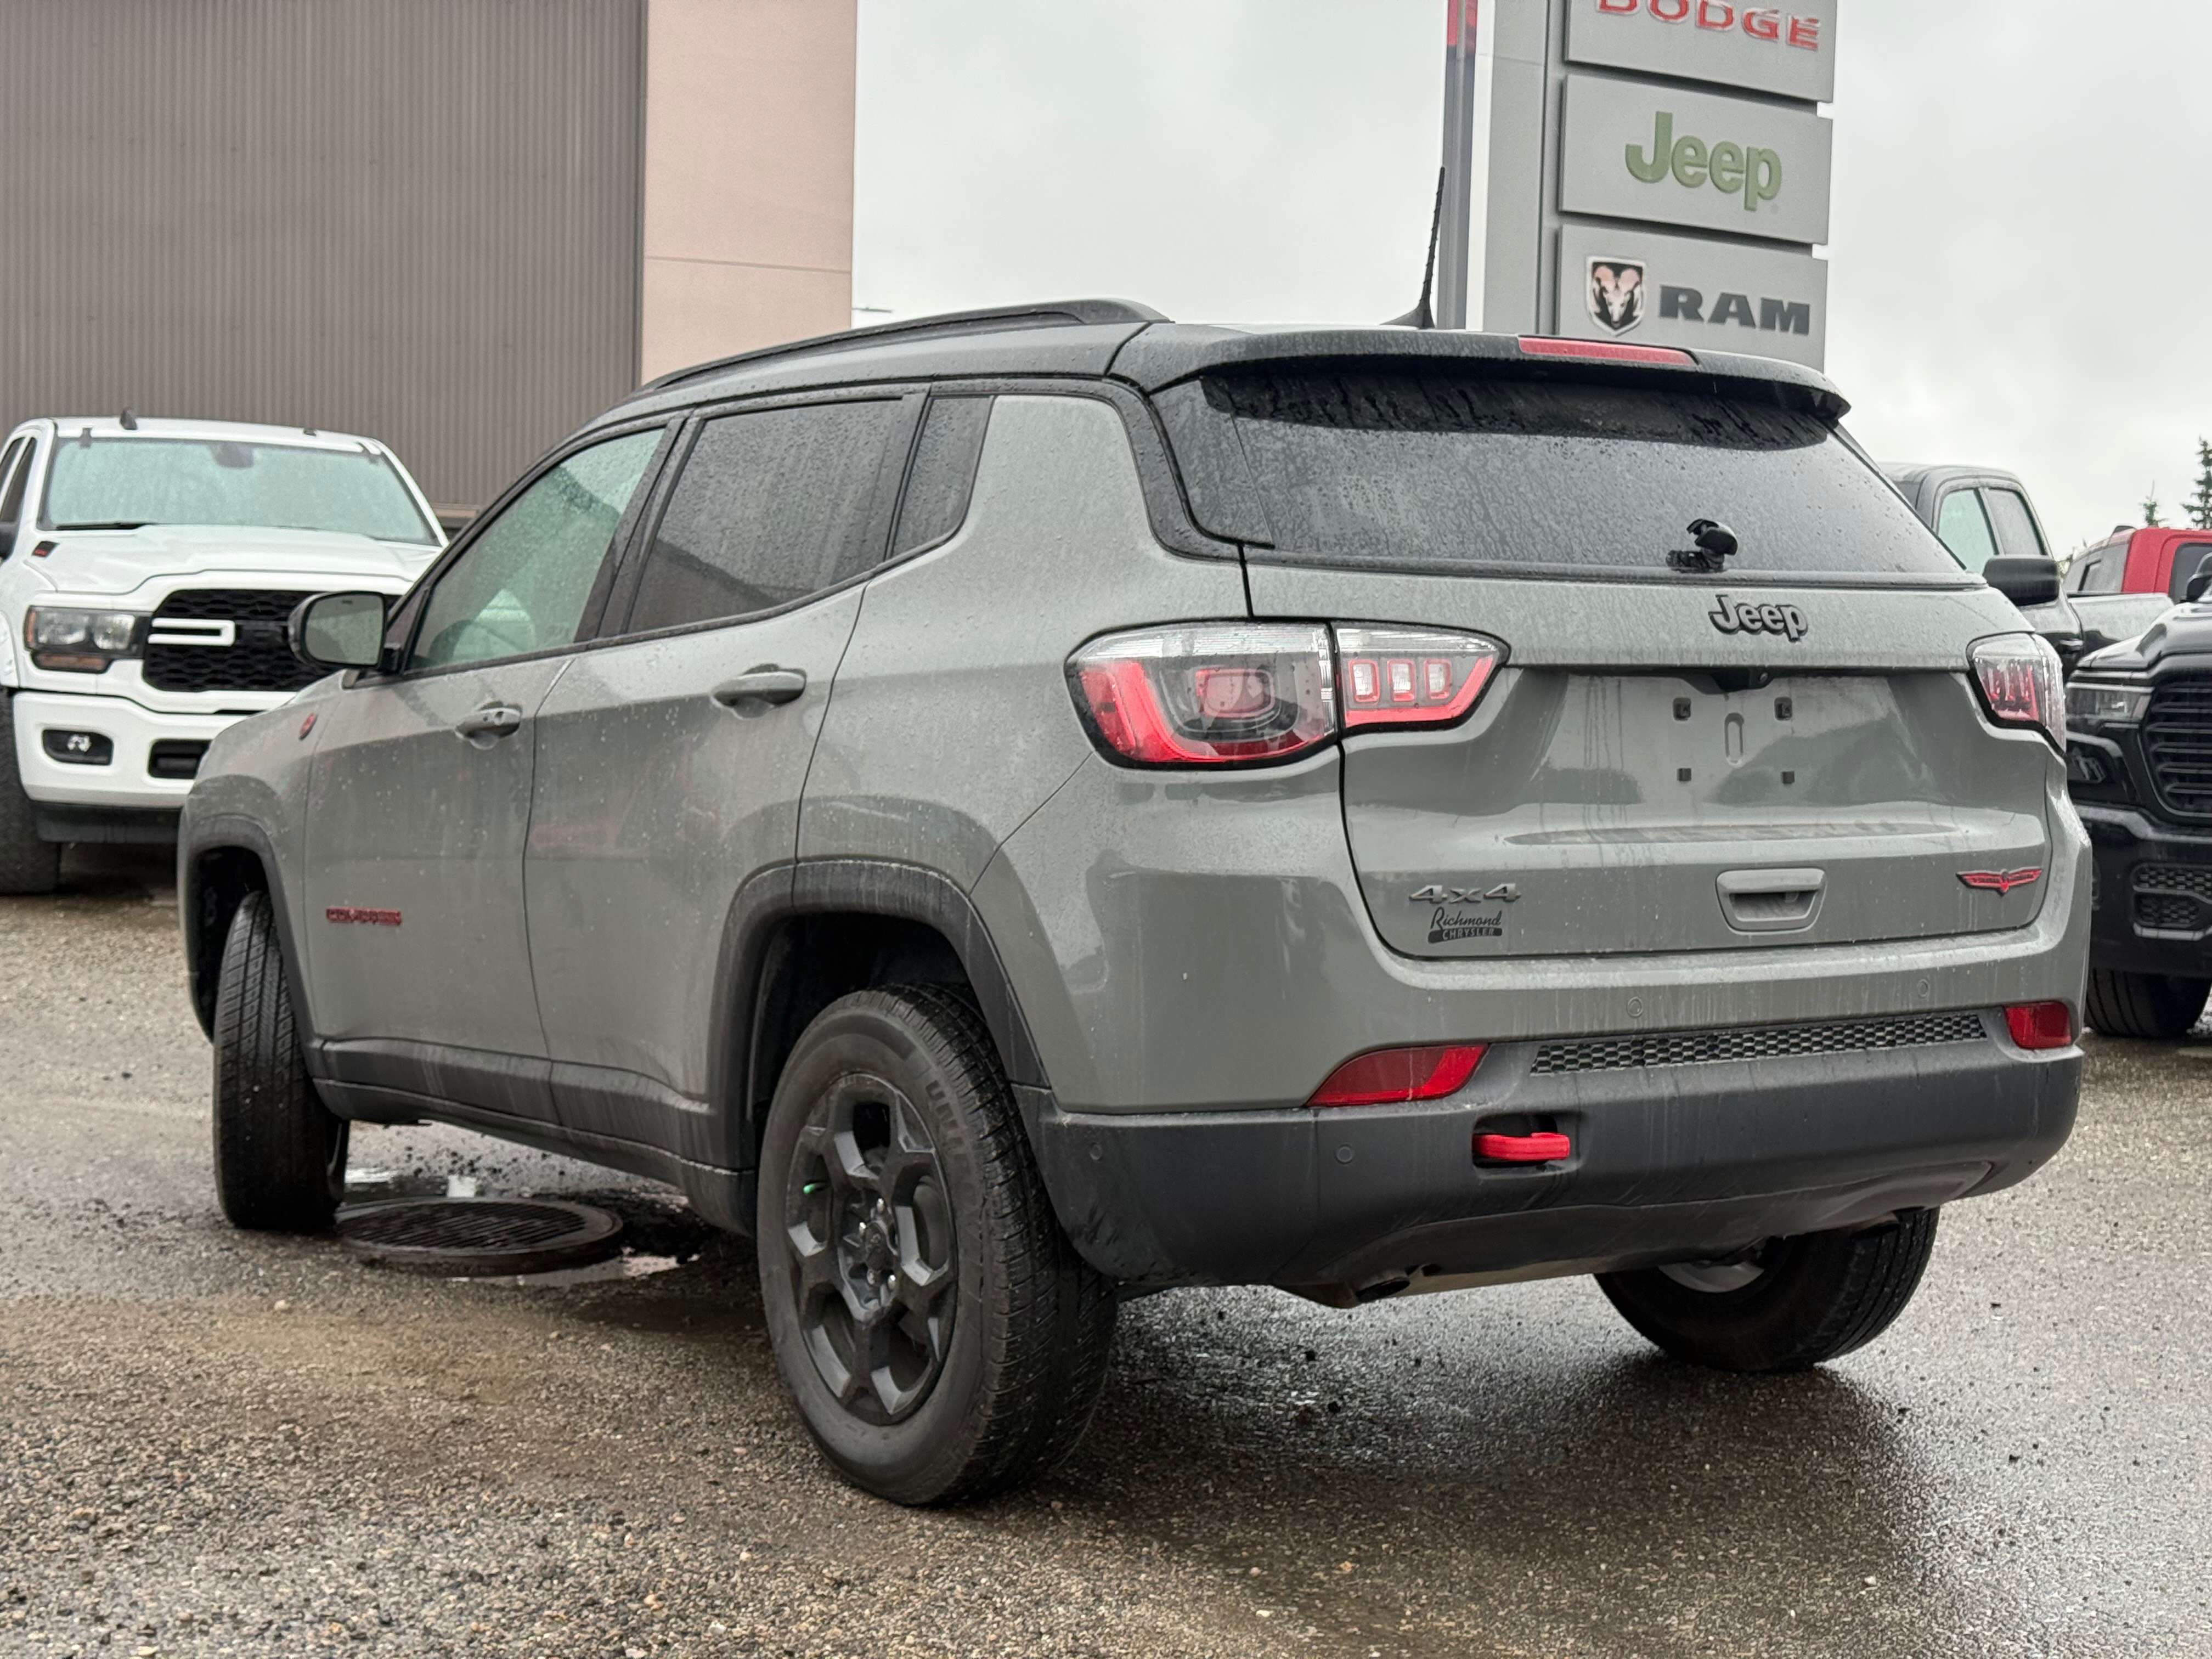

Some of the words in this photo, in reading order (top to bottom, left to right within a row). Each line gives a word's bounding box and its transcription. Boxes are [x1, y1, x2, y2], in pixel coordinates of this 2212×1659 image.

[1625, 111, 1782, 212] Jeep
[1659, 285, 1810, 335] RAM
[1708, 594, 1808, 642] Jeep
[1430, 906, 1503, 929] Richmond
[1442, 927, 1494, 940] CHRYSLER
